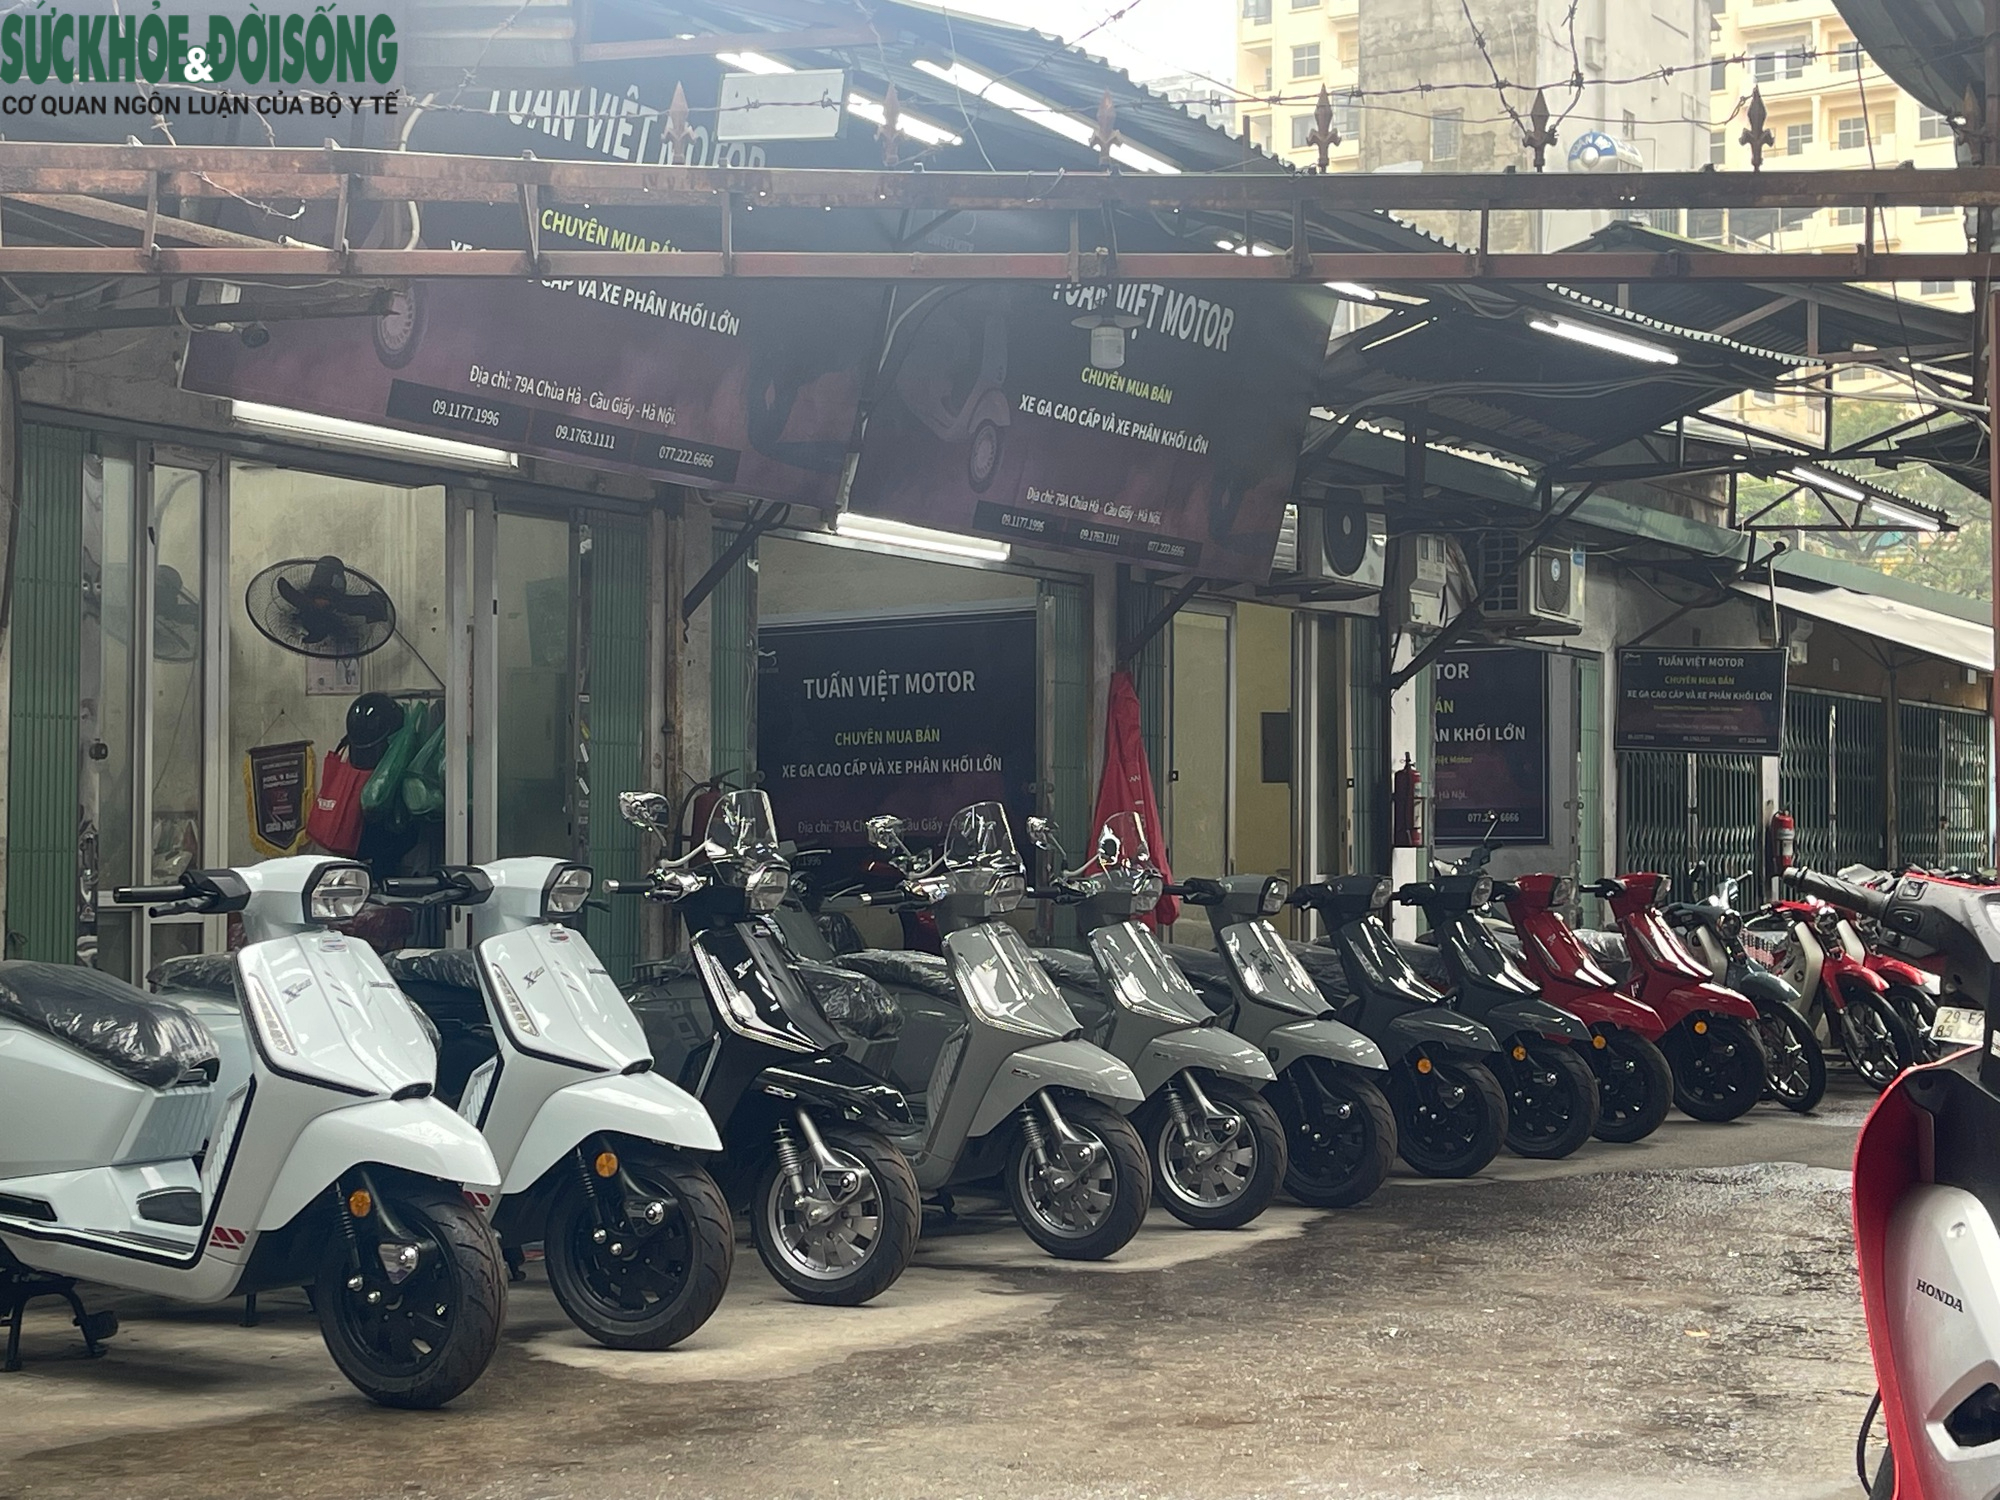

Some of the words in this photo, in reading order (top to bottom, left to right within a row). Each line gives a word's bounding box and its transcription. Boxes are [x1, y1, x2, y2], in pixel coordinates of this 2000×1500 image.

[541, 208, 609, 247] CHUYÊN
[610, 229, 646, 254] MUA
[599, 281, 622, 306] XE
[622, 289, 668, 318] PHÂN
[669, 302, 709, 329] KHỐI
[709, 308, 741, 336] LỚN
[1160, 289, 1235, 351] MOTOR
[469, 364, 490, 388] Địa
[490, 369, 513, 391] chỉ:
[514, 374, 534, 395] 79A
[536, 380, 564, 401] Chùa
[566, 386, 581, 405] Hà
[589, 391, 611, 412] Cầu
[611, 394, 635, 420] Giấy
[641, 403, 656, 422] Hà
[1081, 366, 1126, 393] CHUYÊN
[1126, 378, 1150, 400] MUA
[1150, 383, 1174, 405] BÁN
[432, 399, 501, 427] 09.1177.1996
[1019, 394, 1036, 413] XE
[1037, 398, 1052, 418] GA
[1054, 403, 1077, 423] CAO
[1078, 407, 1101, 429] CẤP
[1102, 412, 1116, 433] VÀ
[1115, 418, 1131, 437] XE
[1131, 422, 1161, 444] PHÂN
[1161, 429, 1188, 448] KHỐI
[1187, 434, 1210, 455] LỚN
[555, 424, 616, 450] 09.1763.1111
[658, 445, 715, 469] 077.222.6666
[1026, 486, 1041, 504] Địa
[1055, 492, 1069, 508] 79A
[1069, 495, 1089, 512] Chùa
[1088, 498, 1100, 514] Hà
[1657, 655, 1684, 668] TUẤN
[1685, 655, 1706, 669] VIỆT
[1708, 656, 1745, 668] MOTOR
[803, 671, 854, 700] TUẤN
[859, 669, 900, 702] VIỆT
[905, 670, 976, 695] MOTOR
[1664, 674, 1698, 685] CHUYÊN
[1698, 676, 1717, 686] MUA
[1627, 689, 1637, 699] XE
[1638, 690, 1650, 699] GA
[1650, 690, 1668, 699] CAO
[1685, 689, 1697, 700] VÀ
[1697, 691, 1707, 700] XE
[835, 728, 883, 747] CHUYÊN
[886, 729, 913, 744] MUA
[915, 725, 941, 743] BÁN
[1454, 723, 1491, 741] KHỐI
[1495, 721, 1526, 741] LỚN
[782, 764, 797, 778] XE
[799, 763, 816, 778] GA
[817, 762, 841, 777] CAO
[844, 757, 867, 777] CẤP
[869, 757, 886, 776] VÀ
[886, 759, 903, 775] XE
[905, 755, 939, 774] PHÂN
[942, 754, 973, 773] KHỐI
[976, 753, 1002, 772] LỚN
[798, 820, 817, 835] Địa
[817, 819, 833, 834] chỉ:
[834, 820, 851, 834] 79A
[899, 816, 920, 833] Cầu
[921, 815, 943, 835] Giấy
[1916, 1278, 1964, 1313] HONDA
